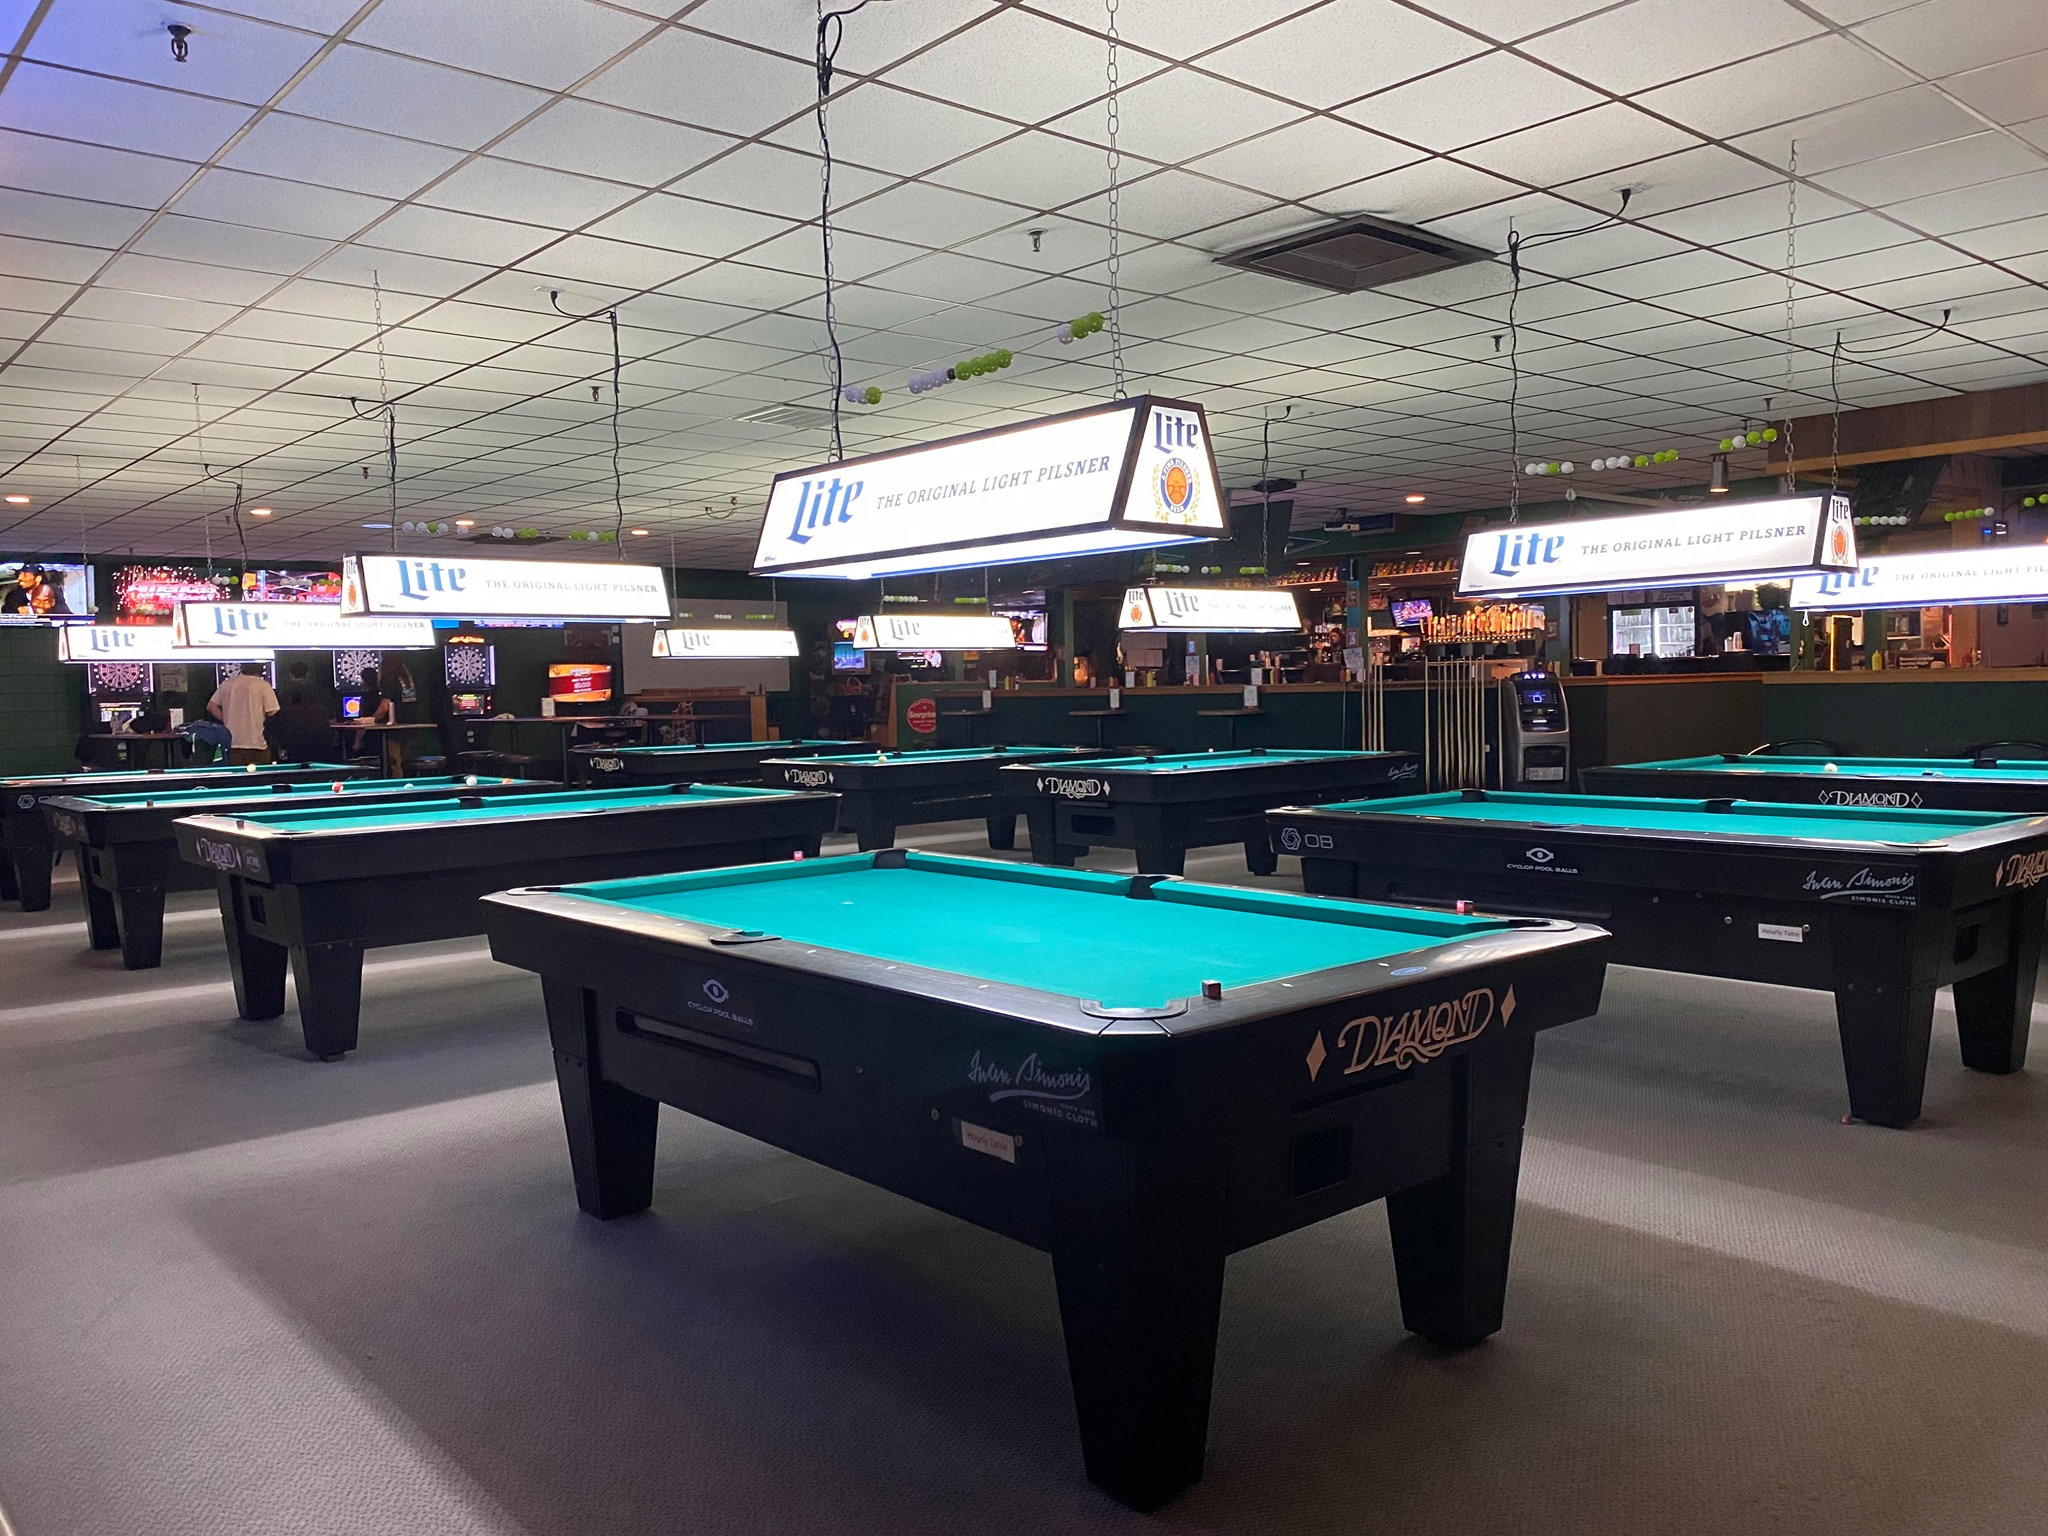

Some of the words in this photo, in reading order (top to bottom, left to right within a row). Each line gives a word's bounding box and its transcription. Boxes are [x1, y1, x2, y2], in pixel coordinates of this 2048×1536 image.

[1153, 411, 1199, 454] Lite
[787, 477, 864, 544] Lite
[877, 494, 903, 509] THE
[907, 480, 977, 505] ORIGINAL
[982, 470, 1033, 492] LIGHT
[1036, 456, 1110, 482] PILSNER
[1832, 499, 1849, 524] Lite
[1489, 534, 1565, 577] Lite
[1581, 544, 1608, 555] THE
[1612, 537, 1682, 552] ORIGINAL
[1687, 532, 1734, 546] LIGHT
[1739, 525, 1806, 541] PILSNER
[397, 559, 466, 600] Lite
[484, 580, 509, 589] THE
[513, 581, 571, 590] ORIGINAL
[574, 582, 608, 591] LIGHT
[613, 583, 658, 593] PILSNER
[1895, 573, 1916, 582] THE
[1921, 569, 1978, 579] ORIGINAL
[1984, 567, 2020, 576] LIGHT
[1128, 590, 1143, 604] Lite
[1165, 590, 1200, 618] Lite
[213, 606, 269, 637] Lite
[890, 618, 920, 640] Lite
[91, 629, 135, 652] Lite
[682, 632, 710, 650] Lite
[790, 769, 827, 787] DIAMOND
[1045, 777, 1100, 799] DIAMOND
[1829, 790, 1909, 807] DIAMOND
[1305, 833, 1333, 849] OB
[1846, 867, 1914, 889] Simonis
[1851, 895, 1886, 904] SIMONIS
[1762, 928, 1782, 938] Hourly
[1784, 930, 1801, 938] Table
[731, 1013, 753, 1026] BALLS
[1338, 988, 1494, 1074] DIAMOND
[1016, 1053, 1090, 1091] Simonis
[1023, 1100, 1062, 1117] SIMONIS
[1066, 1112, 1098, 1128] CLOTH
[966, 1131, 989, 1146] Hourly
[990, 1137, 1008, 1151] Table
